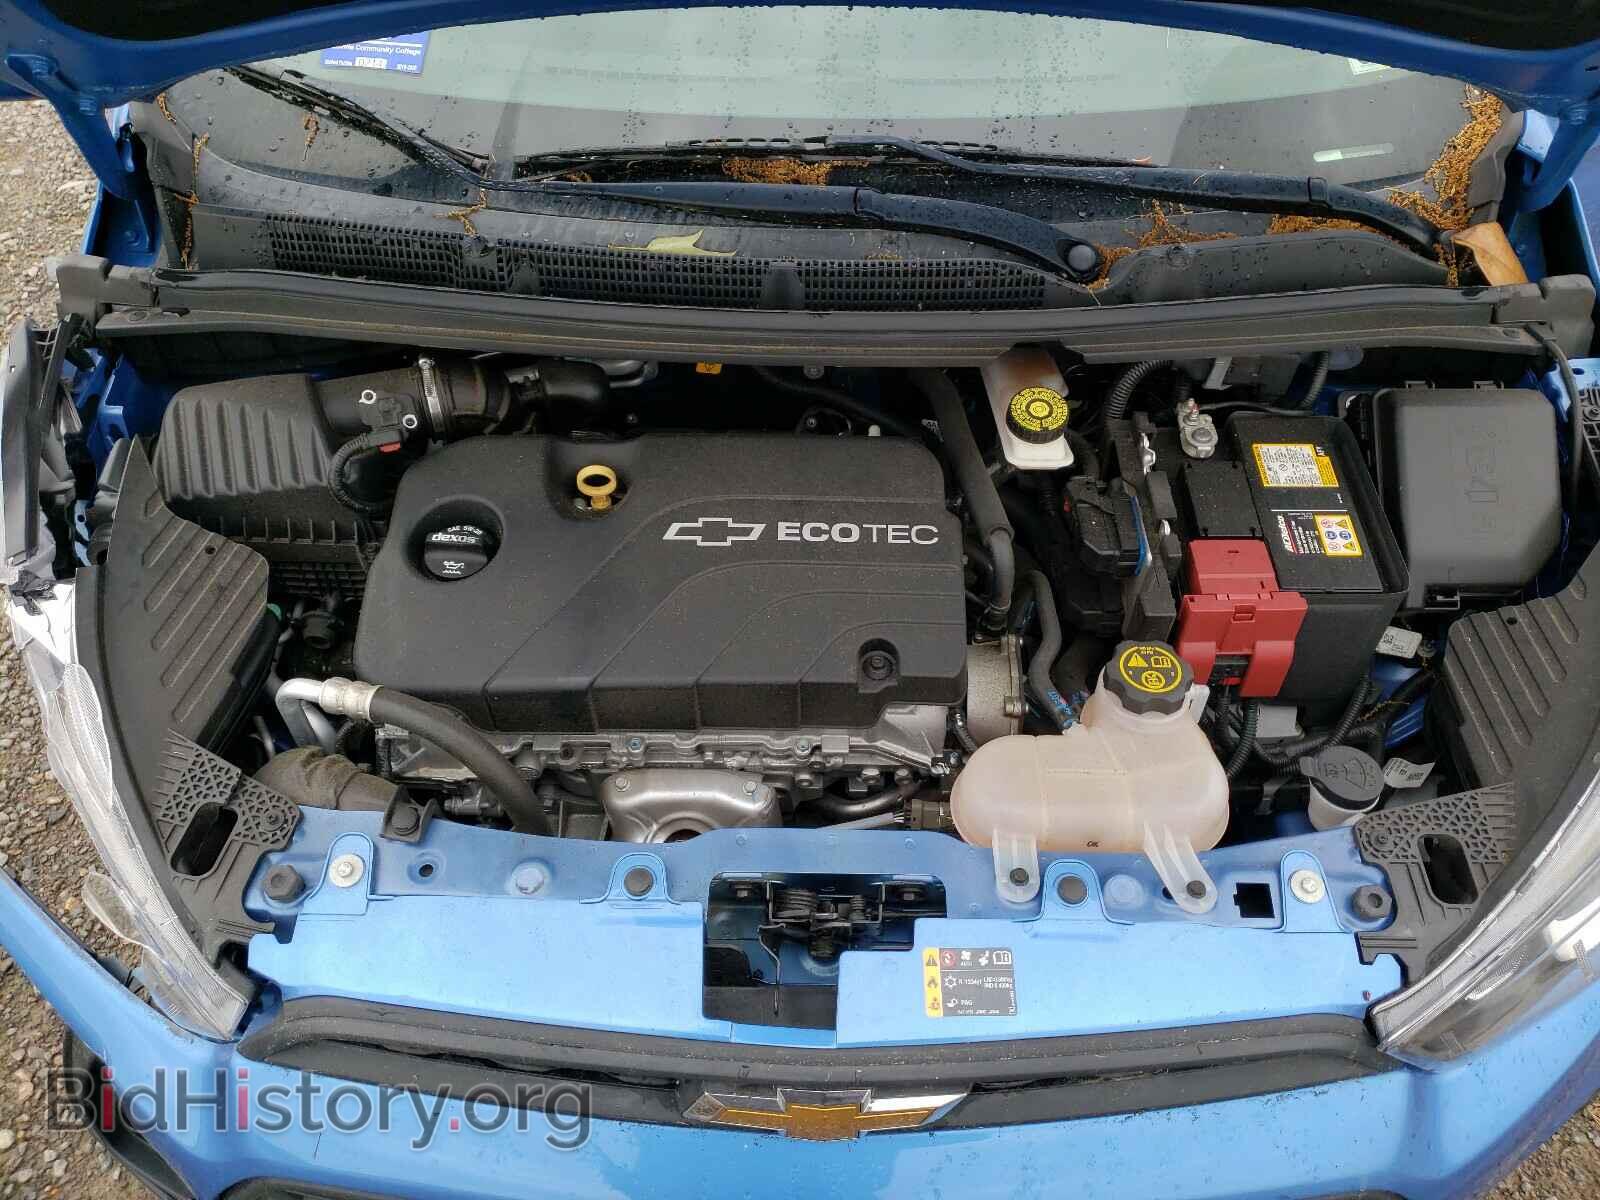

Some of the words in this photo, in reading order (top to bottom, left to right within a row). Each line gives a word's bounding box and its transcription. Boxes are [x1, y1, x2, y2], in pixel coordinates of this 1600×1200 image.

[356, 43, 394, 54] Community
[395, 47, 421, 56] College
[431, 532, 475, 543] dexos
[777, 521, 939, 545] ECOTEC
